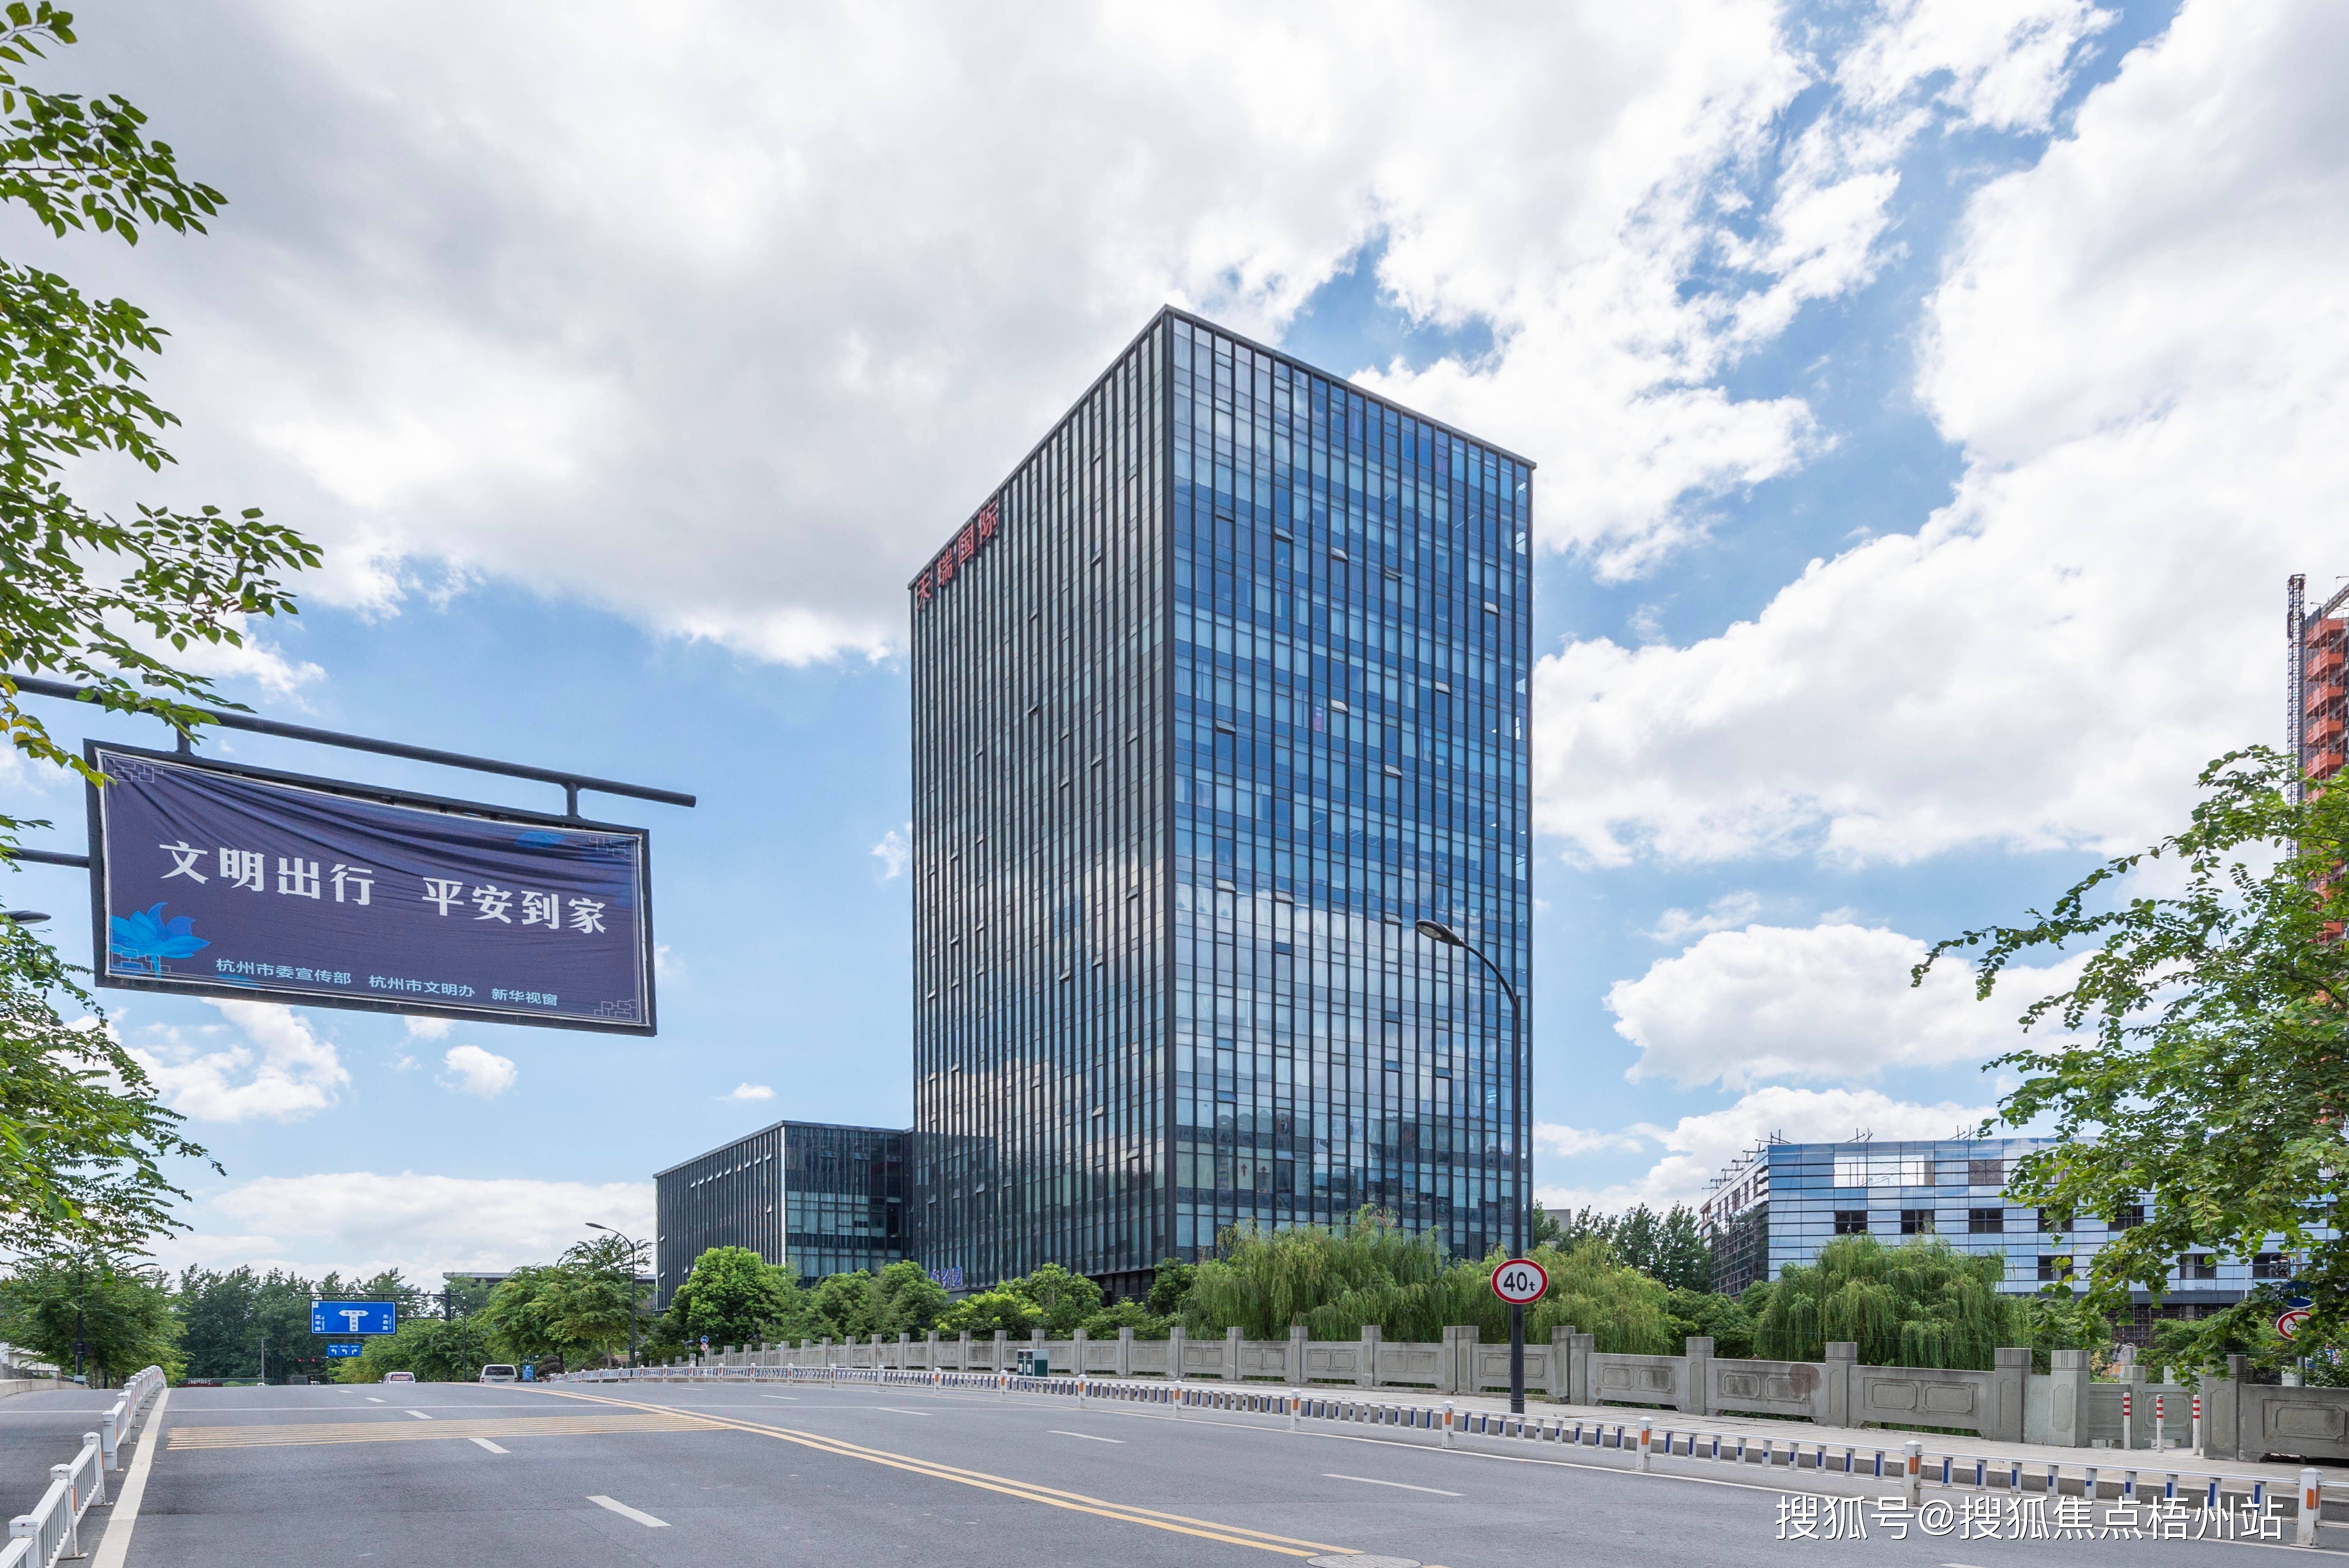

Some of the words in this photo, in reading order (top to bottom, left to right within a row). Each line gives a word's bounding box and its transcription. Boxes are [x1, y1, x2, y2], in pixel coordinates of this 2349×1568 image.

[916, 501, 998, 610] 天瑞国际
[159, 840, 375, 906] 文明出行
[422, 877, 606, 934] 平安到家
[216, 958, 351, 985] 杭州市委宣传部
[369, 975, 476, 998] 杭州市文明办
[491, 988, 558, 1007] 新华视窗
[1503, 1272, 1535, 1292] 40t
